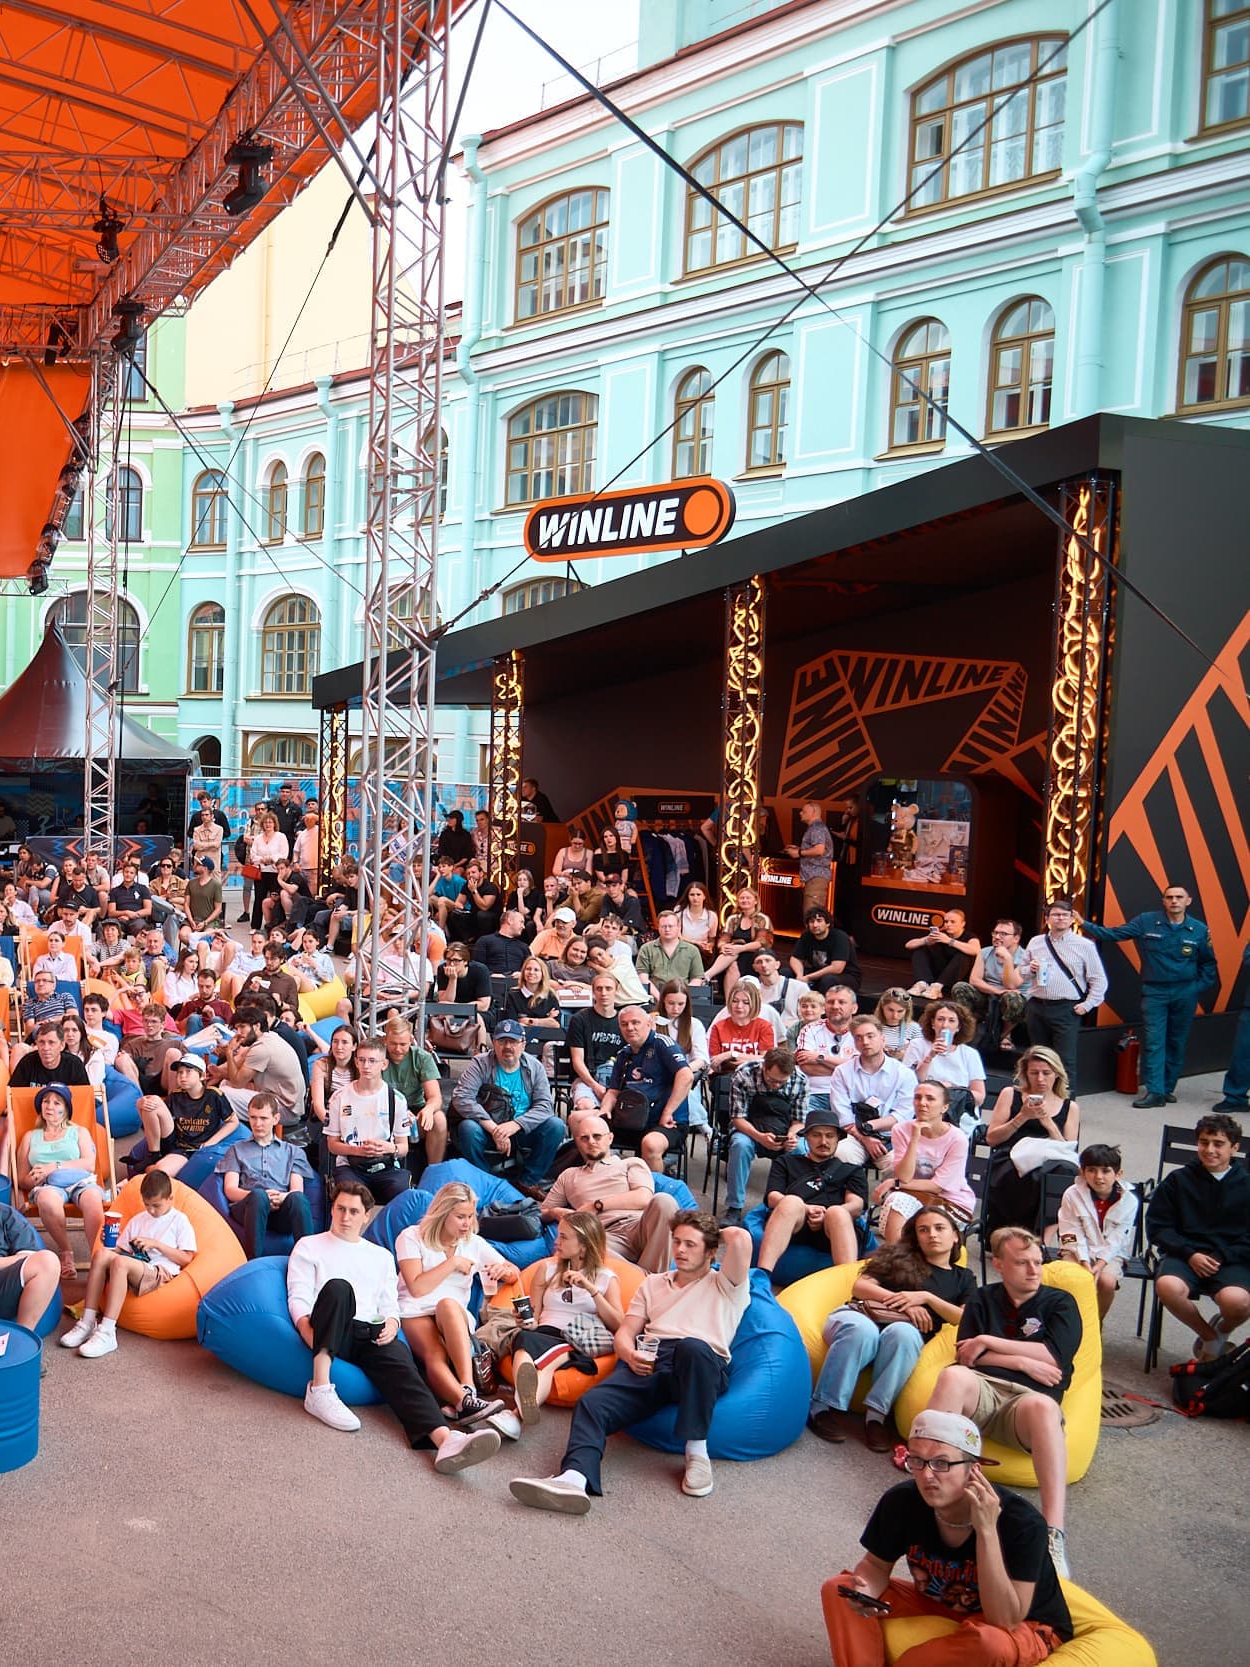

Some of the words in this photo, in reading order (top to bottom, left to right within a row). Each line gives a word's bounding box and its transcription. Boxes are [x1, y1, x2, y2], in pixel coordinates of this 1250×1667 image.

[538, 496, 680, 549] WINLINE
[837, 655, 1011, 712] WINLINE
[760, 873, 792, 885] WINLINE
[877, 908, 930, 925] WINLINE
